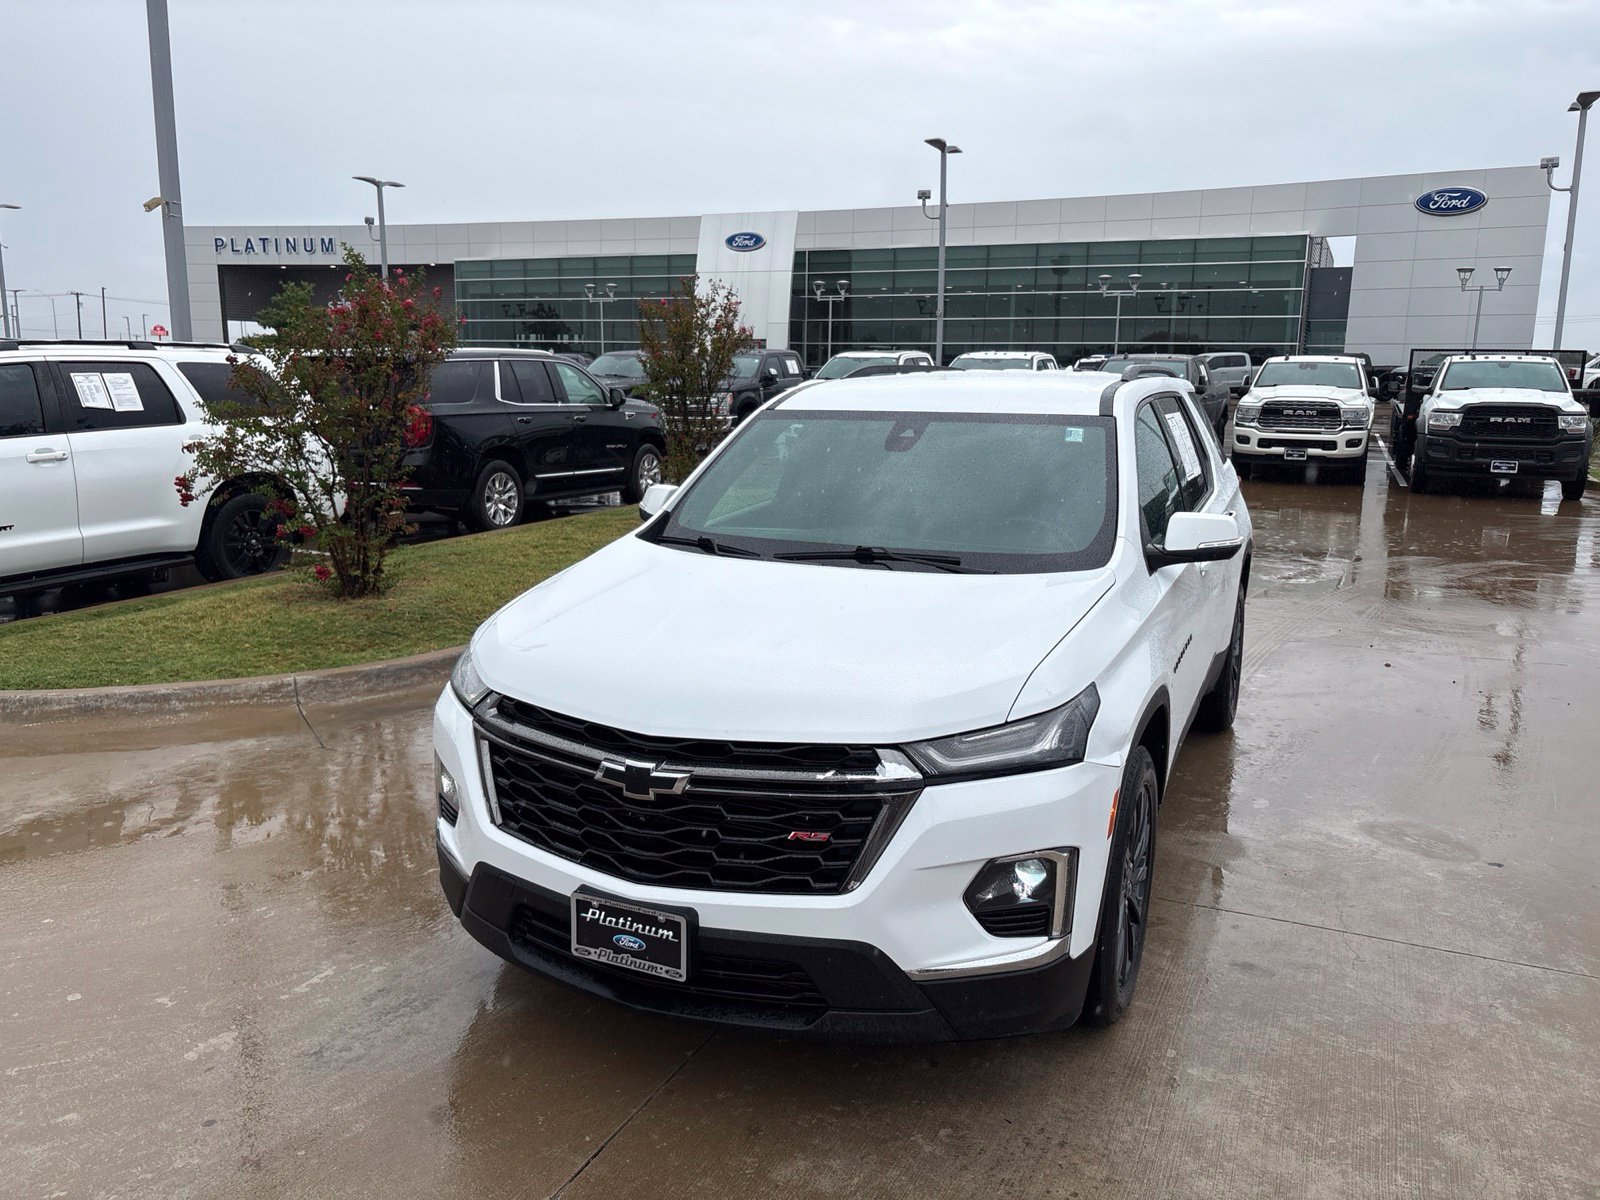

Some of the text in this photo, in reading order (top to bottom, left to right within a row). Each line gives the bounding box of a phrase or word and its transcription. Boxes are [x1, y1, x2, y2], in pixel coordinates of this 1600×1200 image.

[1429, 193, 1471, 209] Ford
[214, 237, 335, 254] PLATINUM
[732, 235, 756, 247] Ford
[788, 831, 830, 841] RS
[580, 908, 679, 943] Platinum
[619, 936, 640, 950] Ford
[596, 949, 664, 975] Platinum
